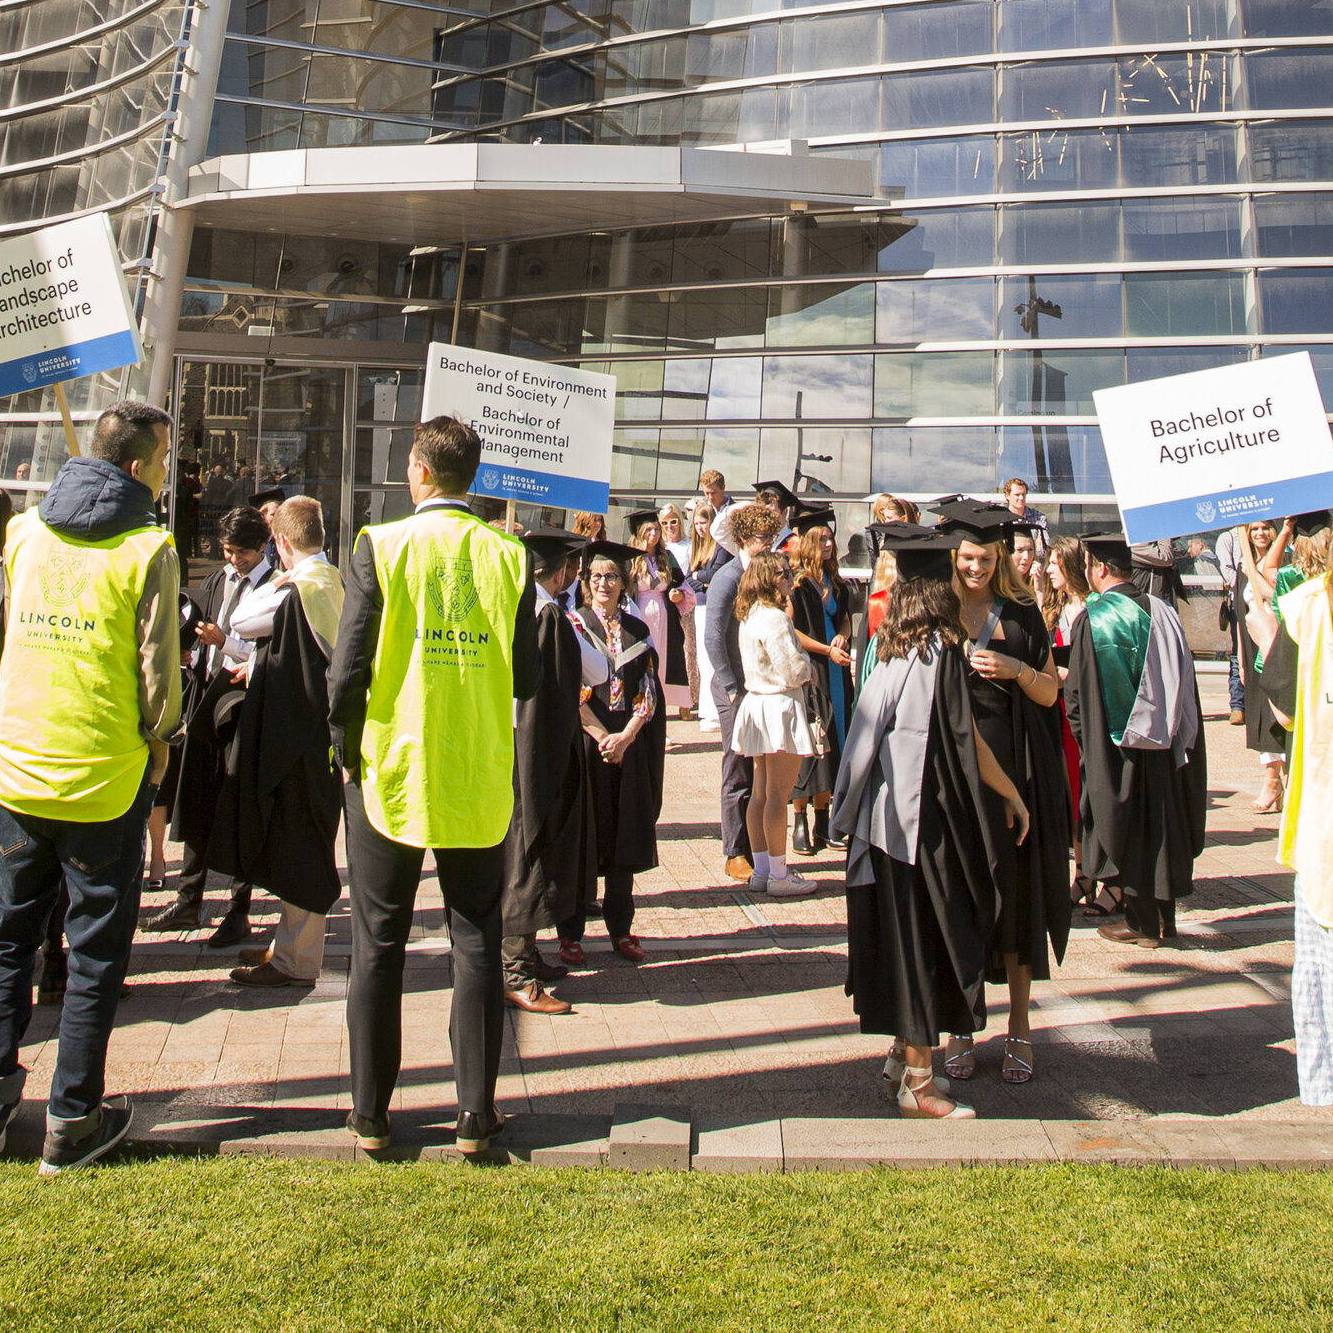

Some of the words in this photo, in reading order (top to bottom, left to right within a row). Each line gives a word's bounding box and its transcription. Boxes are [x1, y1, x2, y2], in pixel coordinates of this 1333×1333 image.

[57, 248, 75, 268] of
[38, 355, 67, 368] LINCOLN
[39, 357, 81, 373] UNIVERSITY
[440, 357, 502, 379] Bachelor
[505, 369, 520, 383] of
[523, 372, 607, 399] Environment
[476, 381, 503, 396] and
[506, 386, 557, 407] Society
[482, 406, 543, 427] Bachelor
[546, 418, 561, 431] of
[1150, 407, 1245, 438] Bachelor
[1252, 397, 1274, 418] of
[470, 420, 570, 448] Environmental
[1159, 428, 1281, 465] Agriculture
[502, 480, 549, 493] UNIVERSITY
[503, 474, 535, 484] LINCOLN
[1217, 494, 1257, 507] LINCOLN
[1219, 497, 1274, 514] UNIVERSITY
[20, 611, 96, 631] LINCOLN
[26, 630, 84, 644] UNIVERSITY
[415, 628, 489, 644] LINCOLN
[425, 647, 478, 657] UNIVERSITY
